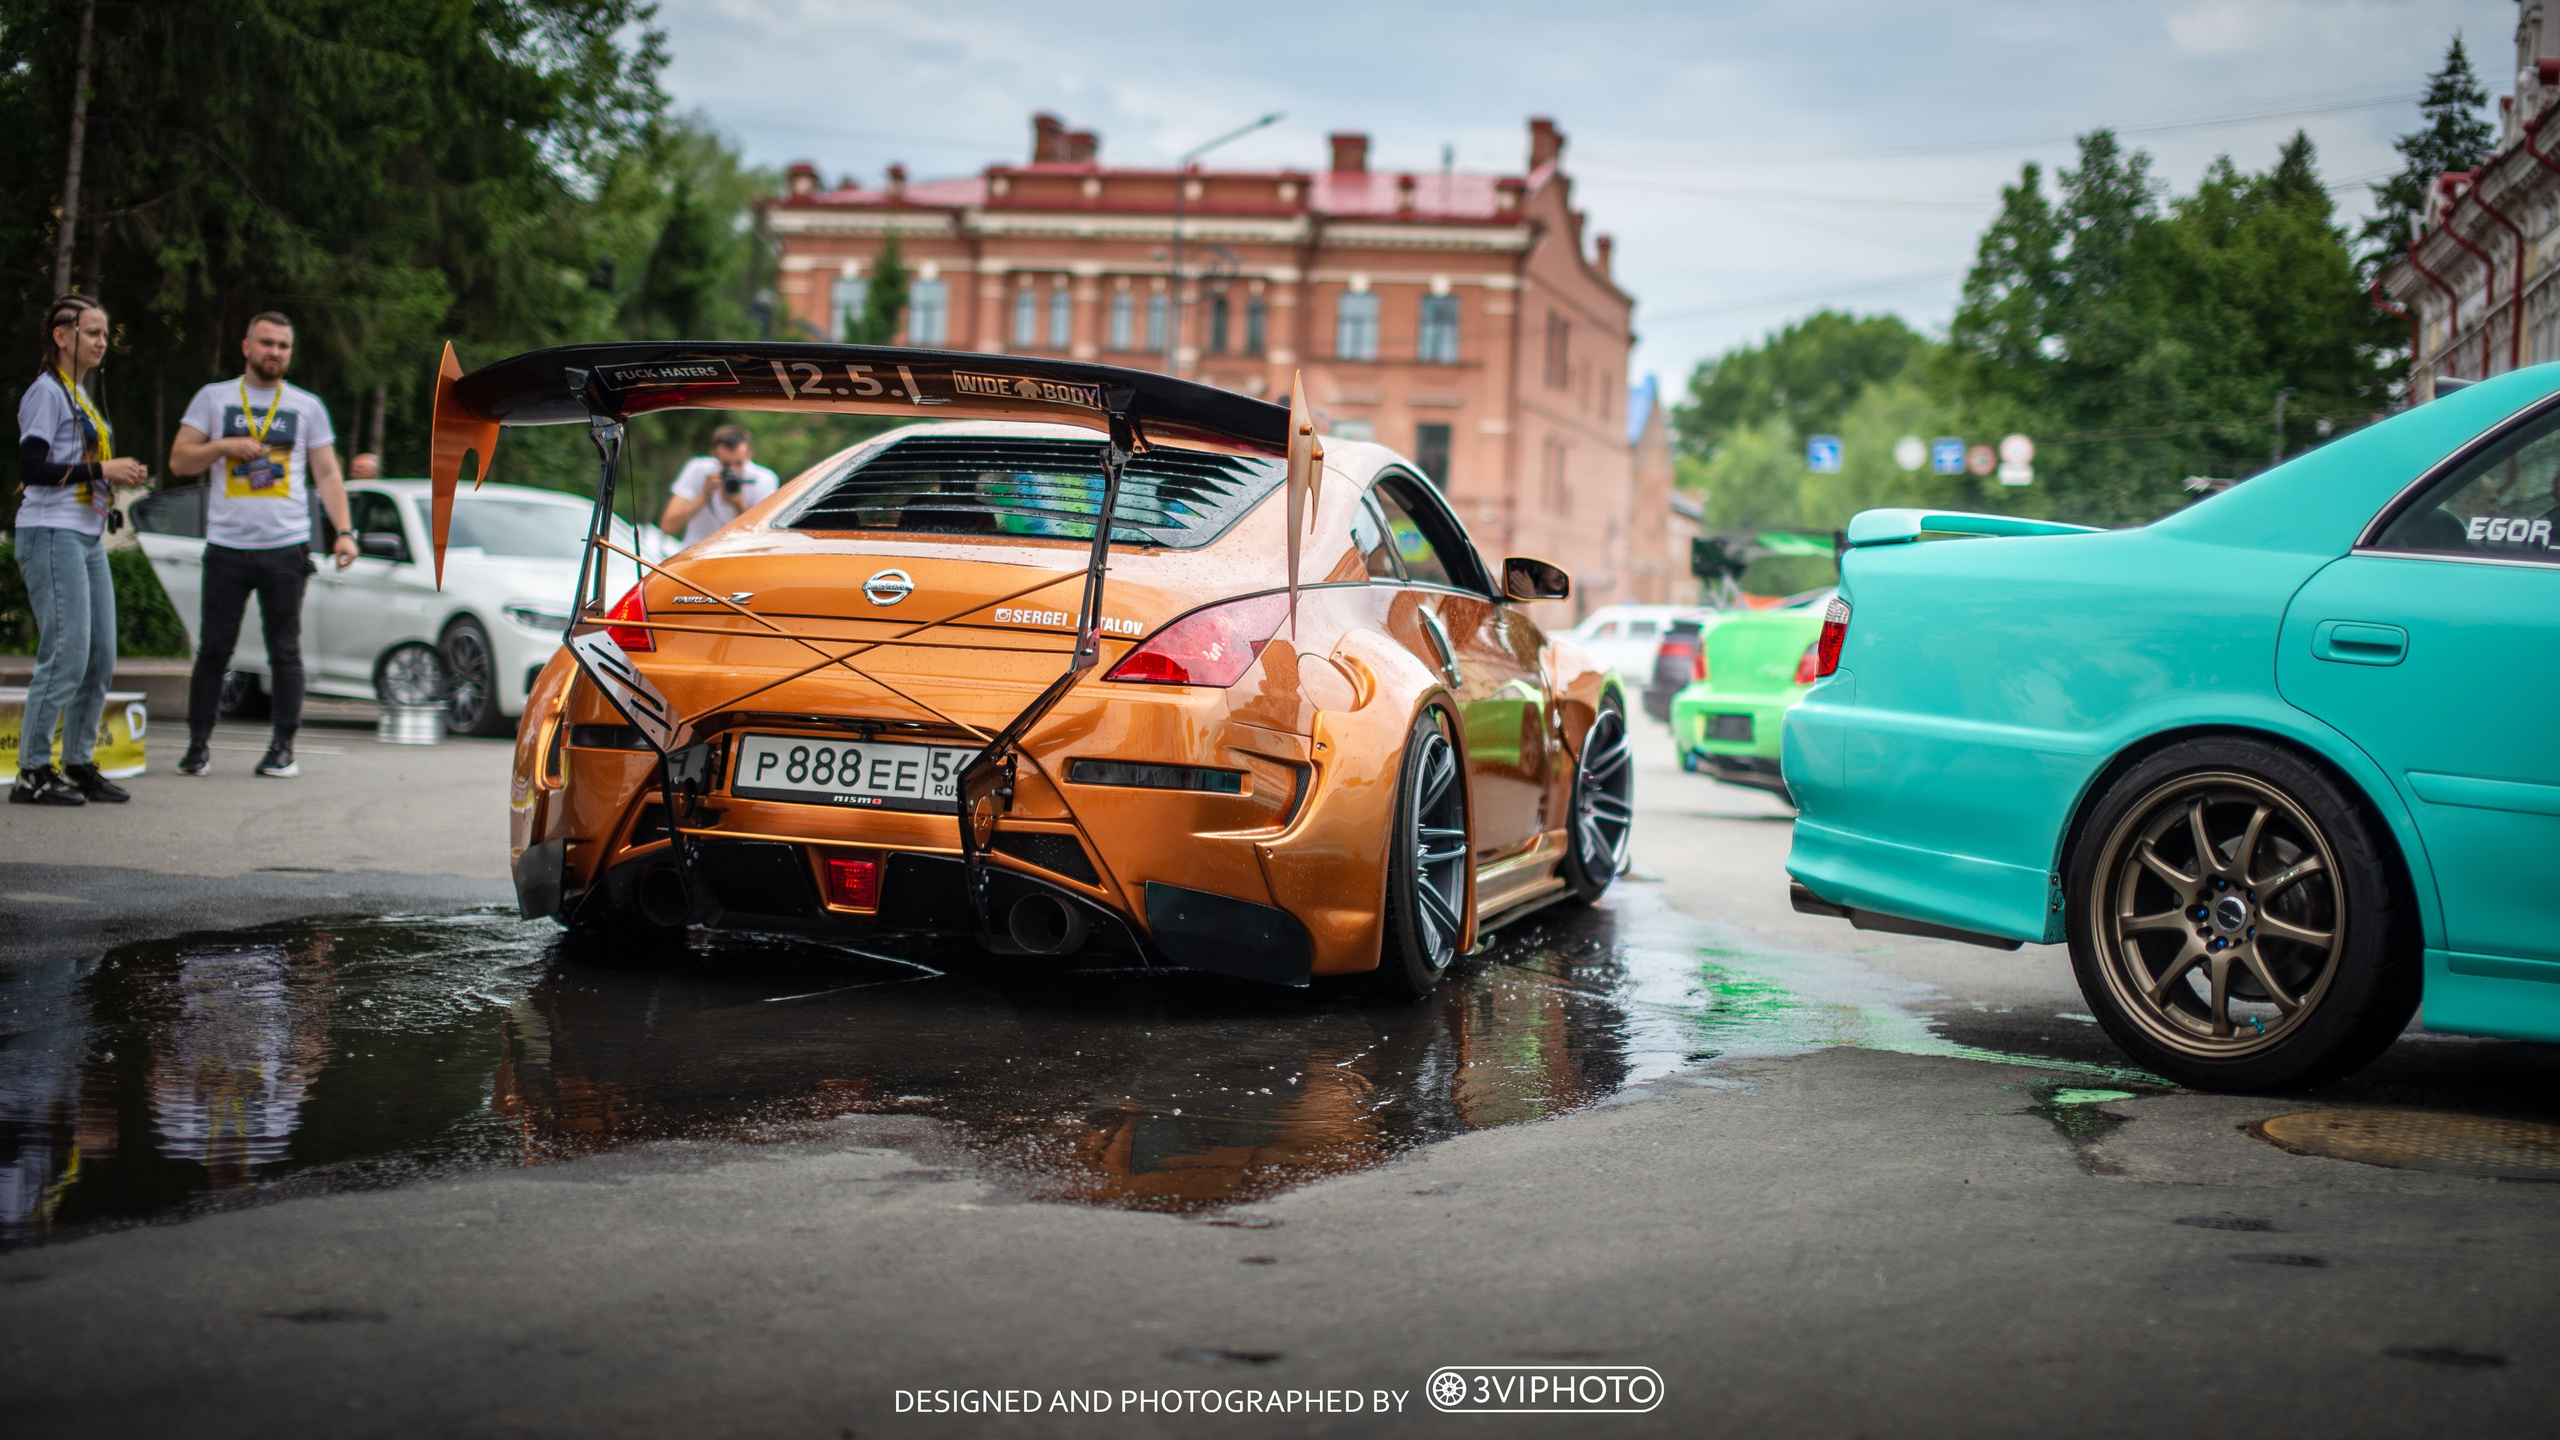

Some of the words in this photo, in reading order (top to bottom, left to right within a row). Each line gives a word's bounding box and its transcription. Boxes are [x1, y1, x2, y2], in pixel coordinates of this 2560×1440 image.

[614, 368, 657, 382] FUCK
[658, 366, 719, 378] HATERS
[957, 374, 1012, 395] WIDE
[1042, 383, 1098, 406] BODY
[833, 795, 882, 805] nismo
